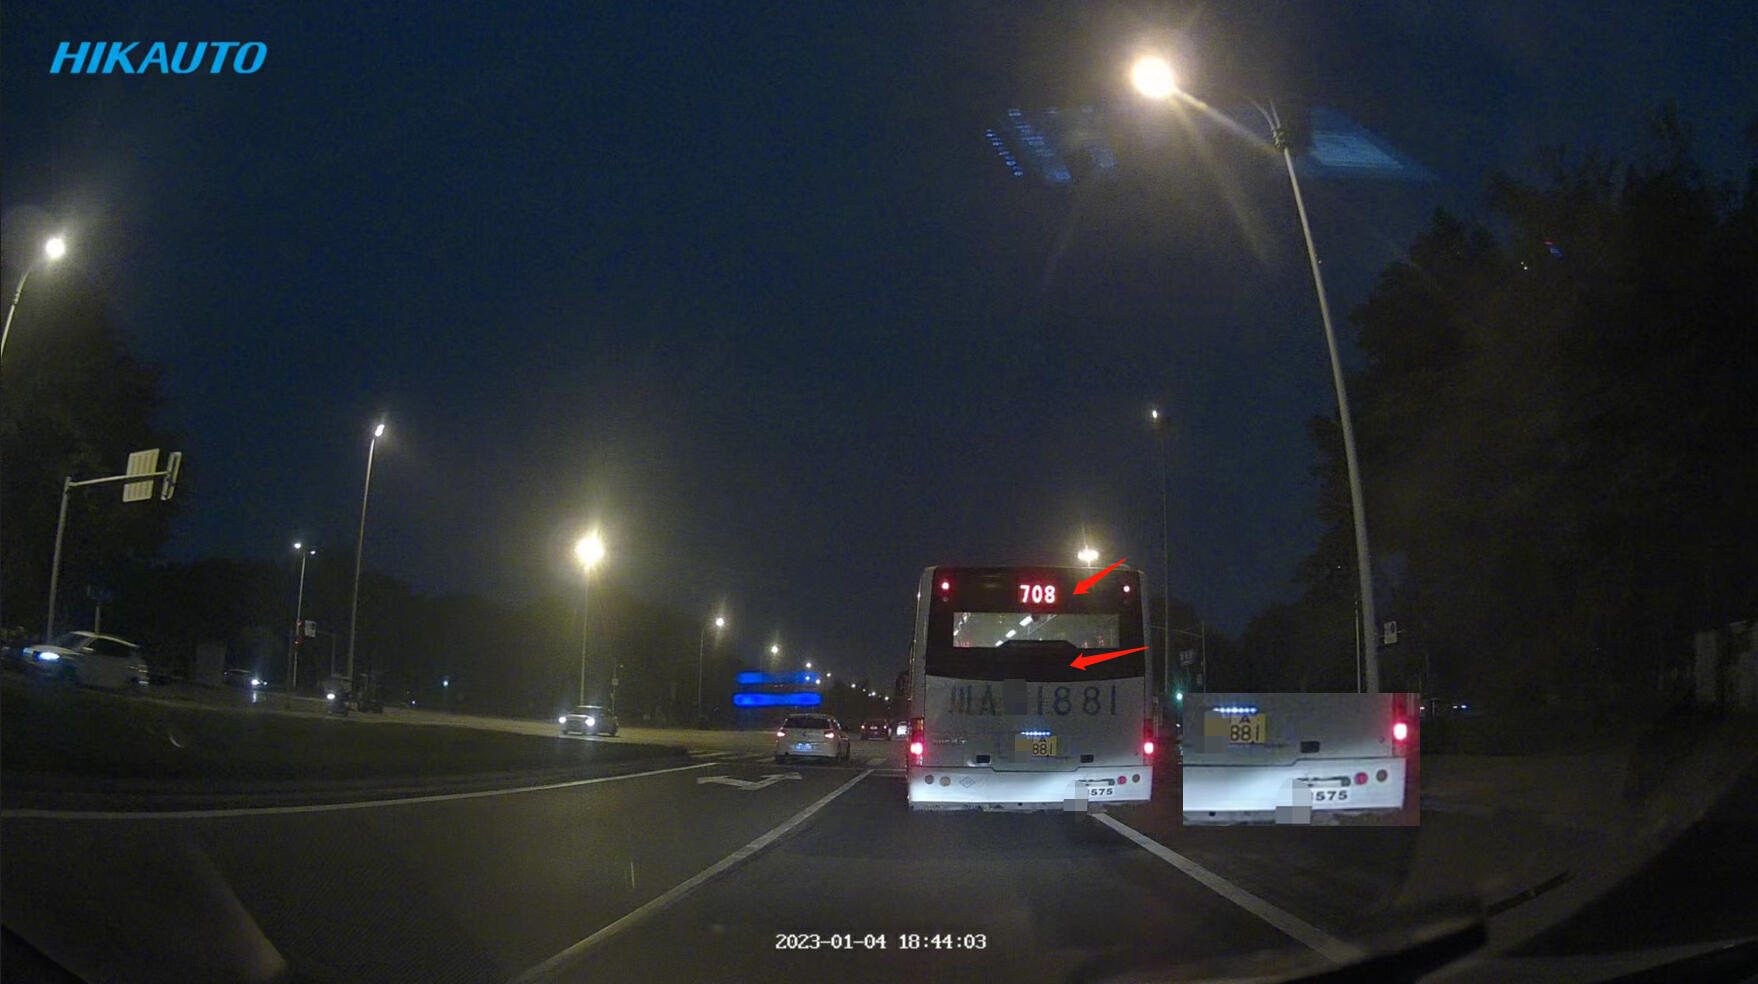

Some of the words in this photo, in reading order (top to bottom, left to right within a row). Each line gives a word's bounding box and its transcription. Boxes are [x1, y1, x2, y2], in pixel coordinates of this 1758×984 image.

[1019, 584, 1056, 604] 708
[1037, 685, 1117, 716] 1881
[1088, 787, 1113, 796] 575
[1312, 790, 1349, 801] 575
